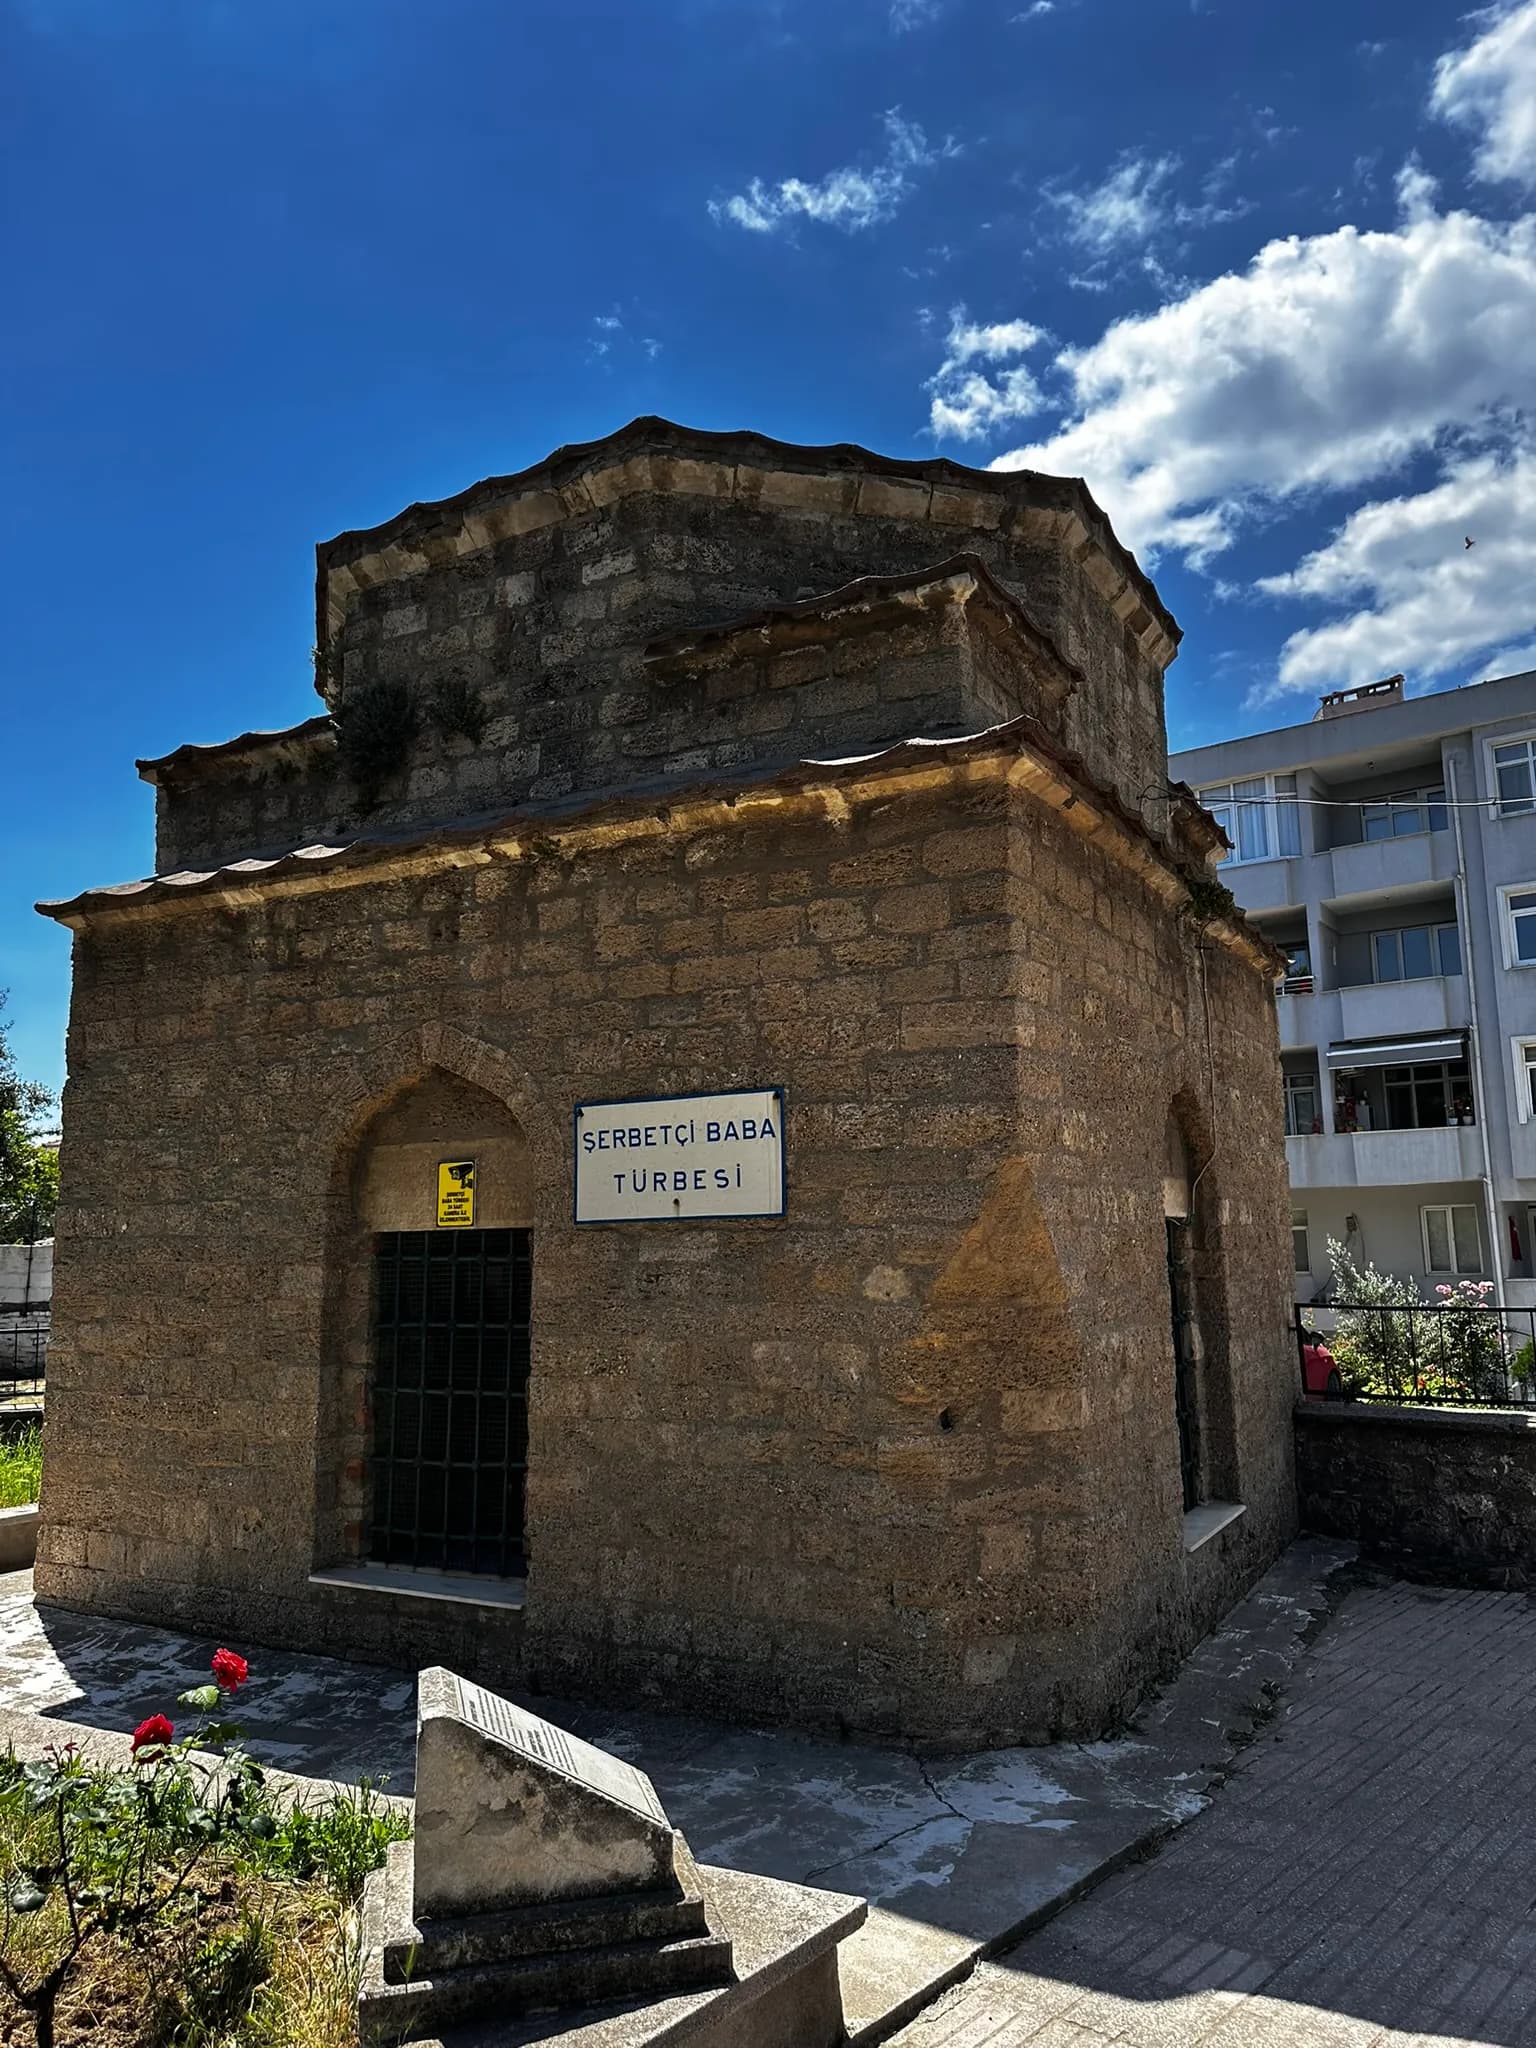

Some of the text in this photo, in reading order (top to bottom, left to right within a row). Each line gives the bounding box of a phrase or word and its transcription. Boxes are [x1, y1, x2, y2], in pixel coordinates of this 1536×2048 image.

[583, 1118, 776, 1153] ŞERBETÇİ BABA
[613, 1163, 741, 1194] TÜRBESİ
